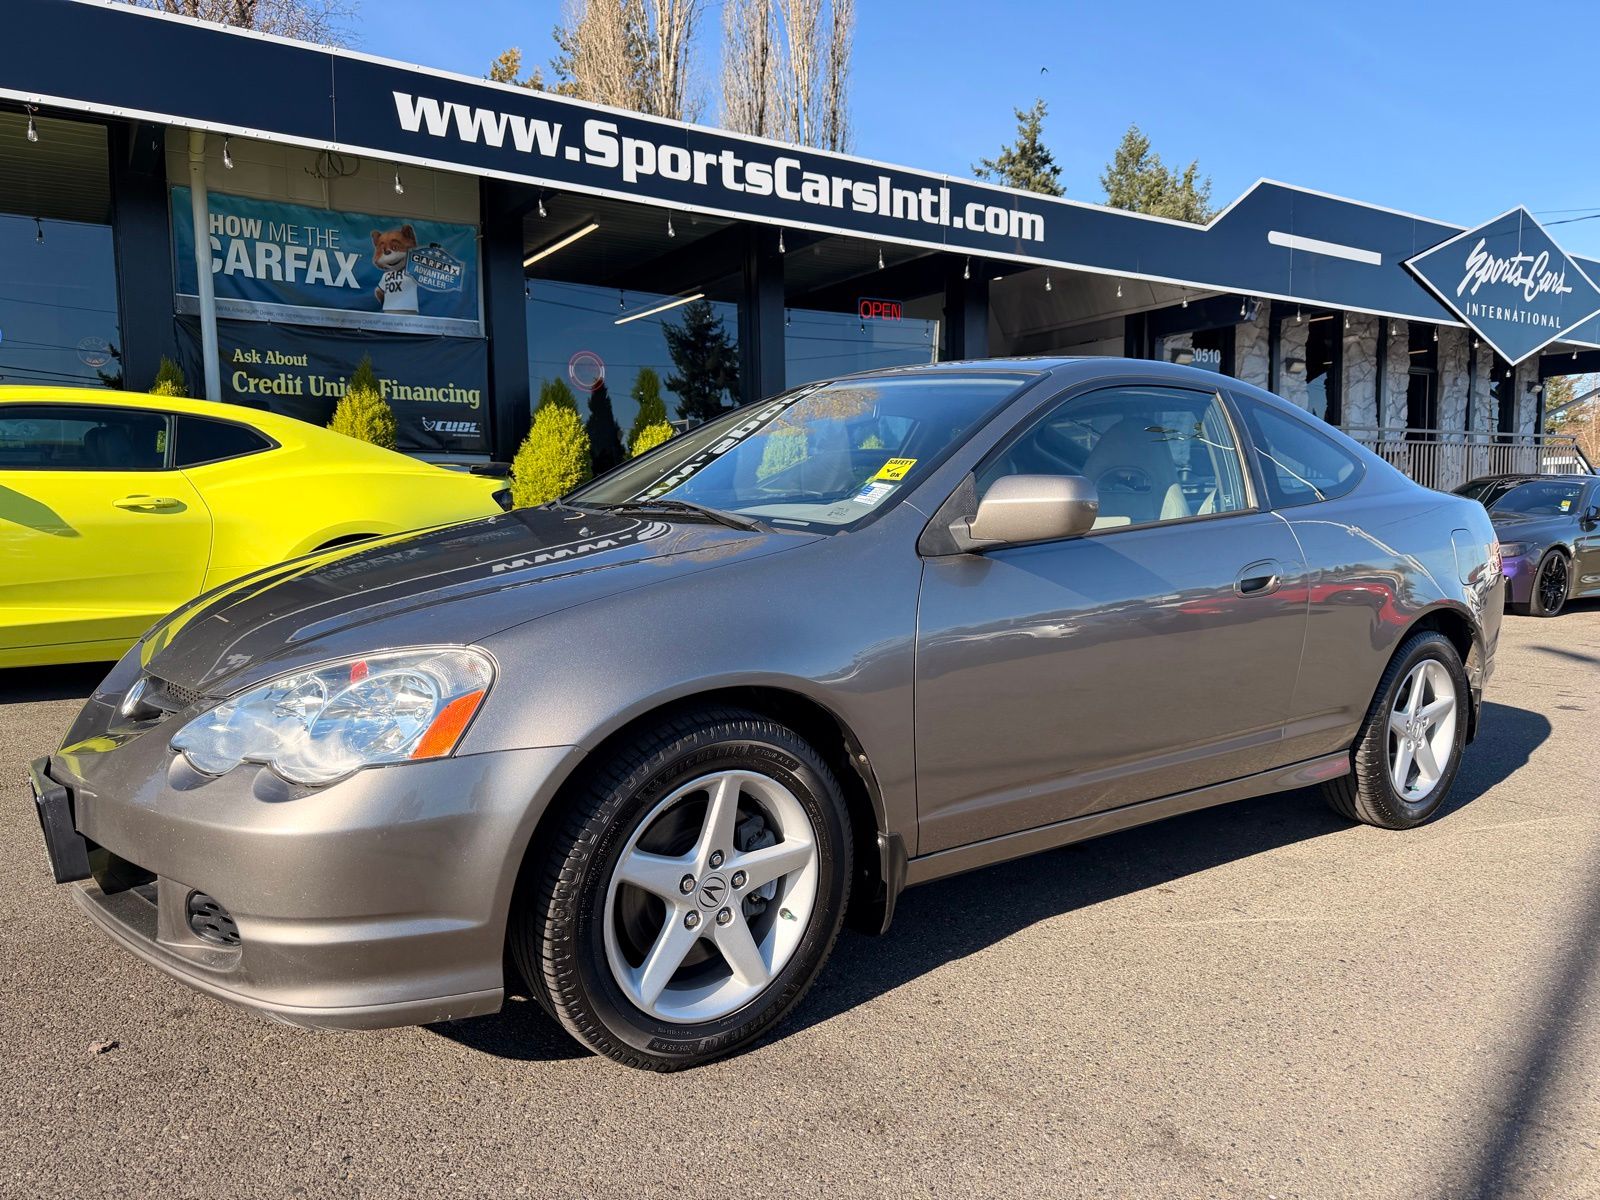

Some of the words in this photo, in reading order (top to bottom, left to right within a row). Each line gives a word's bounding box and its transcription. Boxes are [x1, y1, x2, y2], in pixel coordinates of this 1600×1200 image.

[391, 91, 1045, 242] www.SportsCarsIntl.com
[208, 213, 263, 240] HOW
[268, 221, 300, 245] ME
[303, 226, 341, 250] THE
[412, 254, 460, 276] CARFAX
[413, 265, 456, 284] ADVANTAGE
[1456, 238, 1534, 298] Sports
[1524, 250, 1573, 303] Cars
[384, 281, 403, 294] FOX
[417, 275, 447, 290] DEALER
[860, 300, 902, 322] OPEN
[1465, 302, 1562, 330] INTERNATIONAL
[232, 348, 262, 364] Ask
[264, 350, 308, 367] About
[232, 371, 303, 396] Credit
[378, 378, 481, 410] Financing
